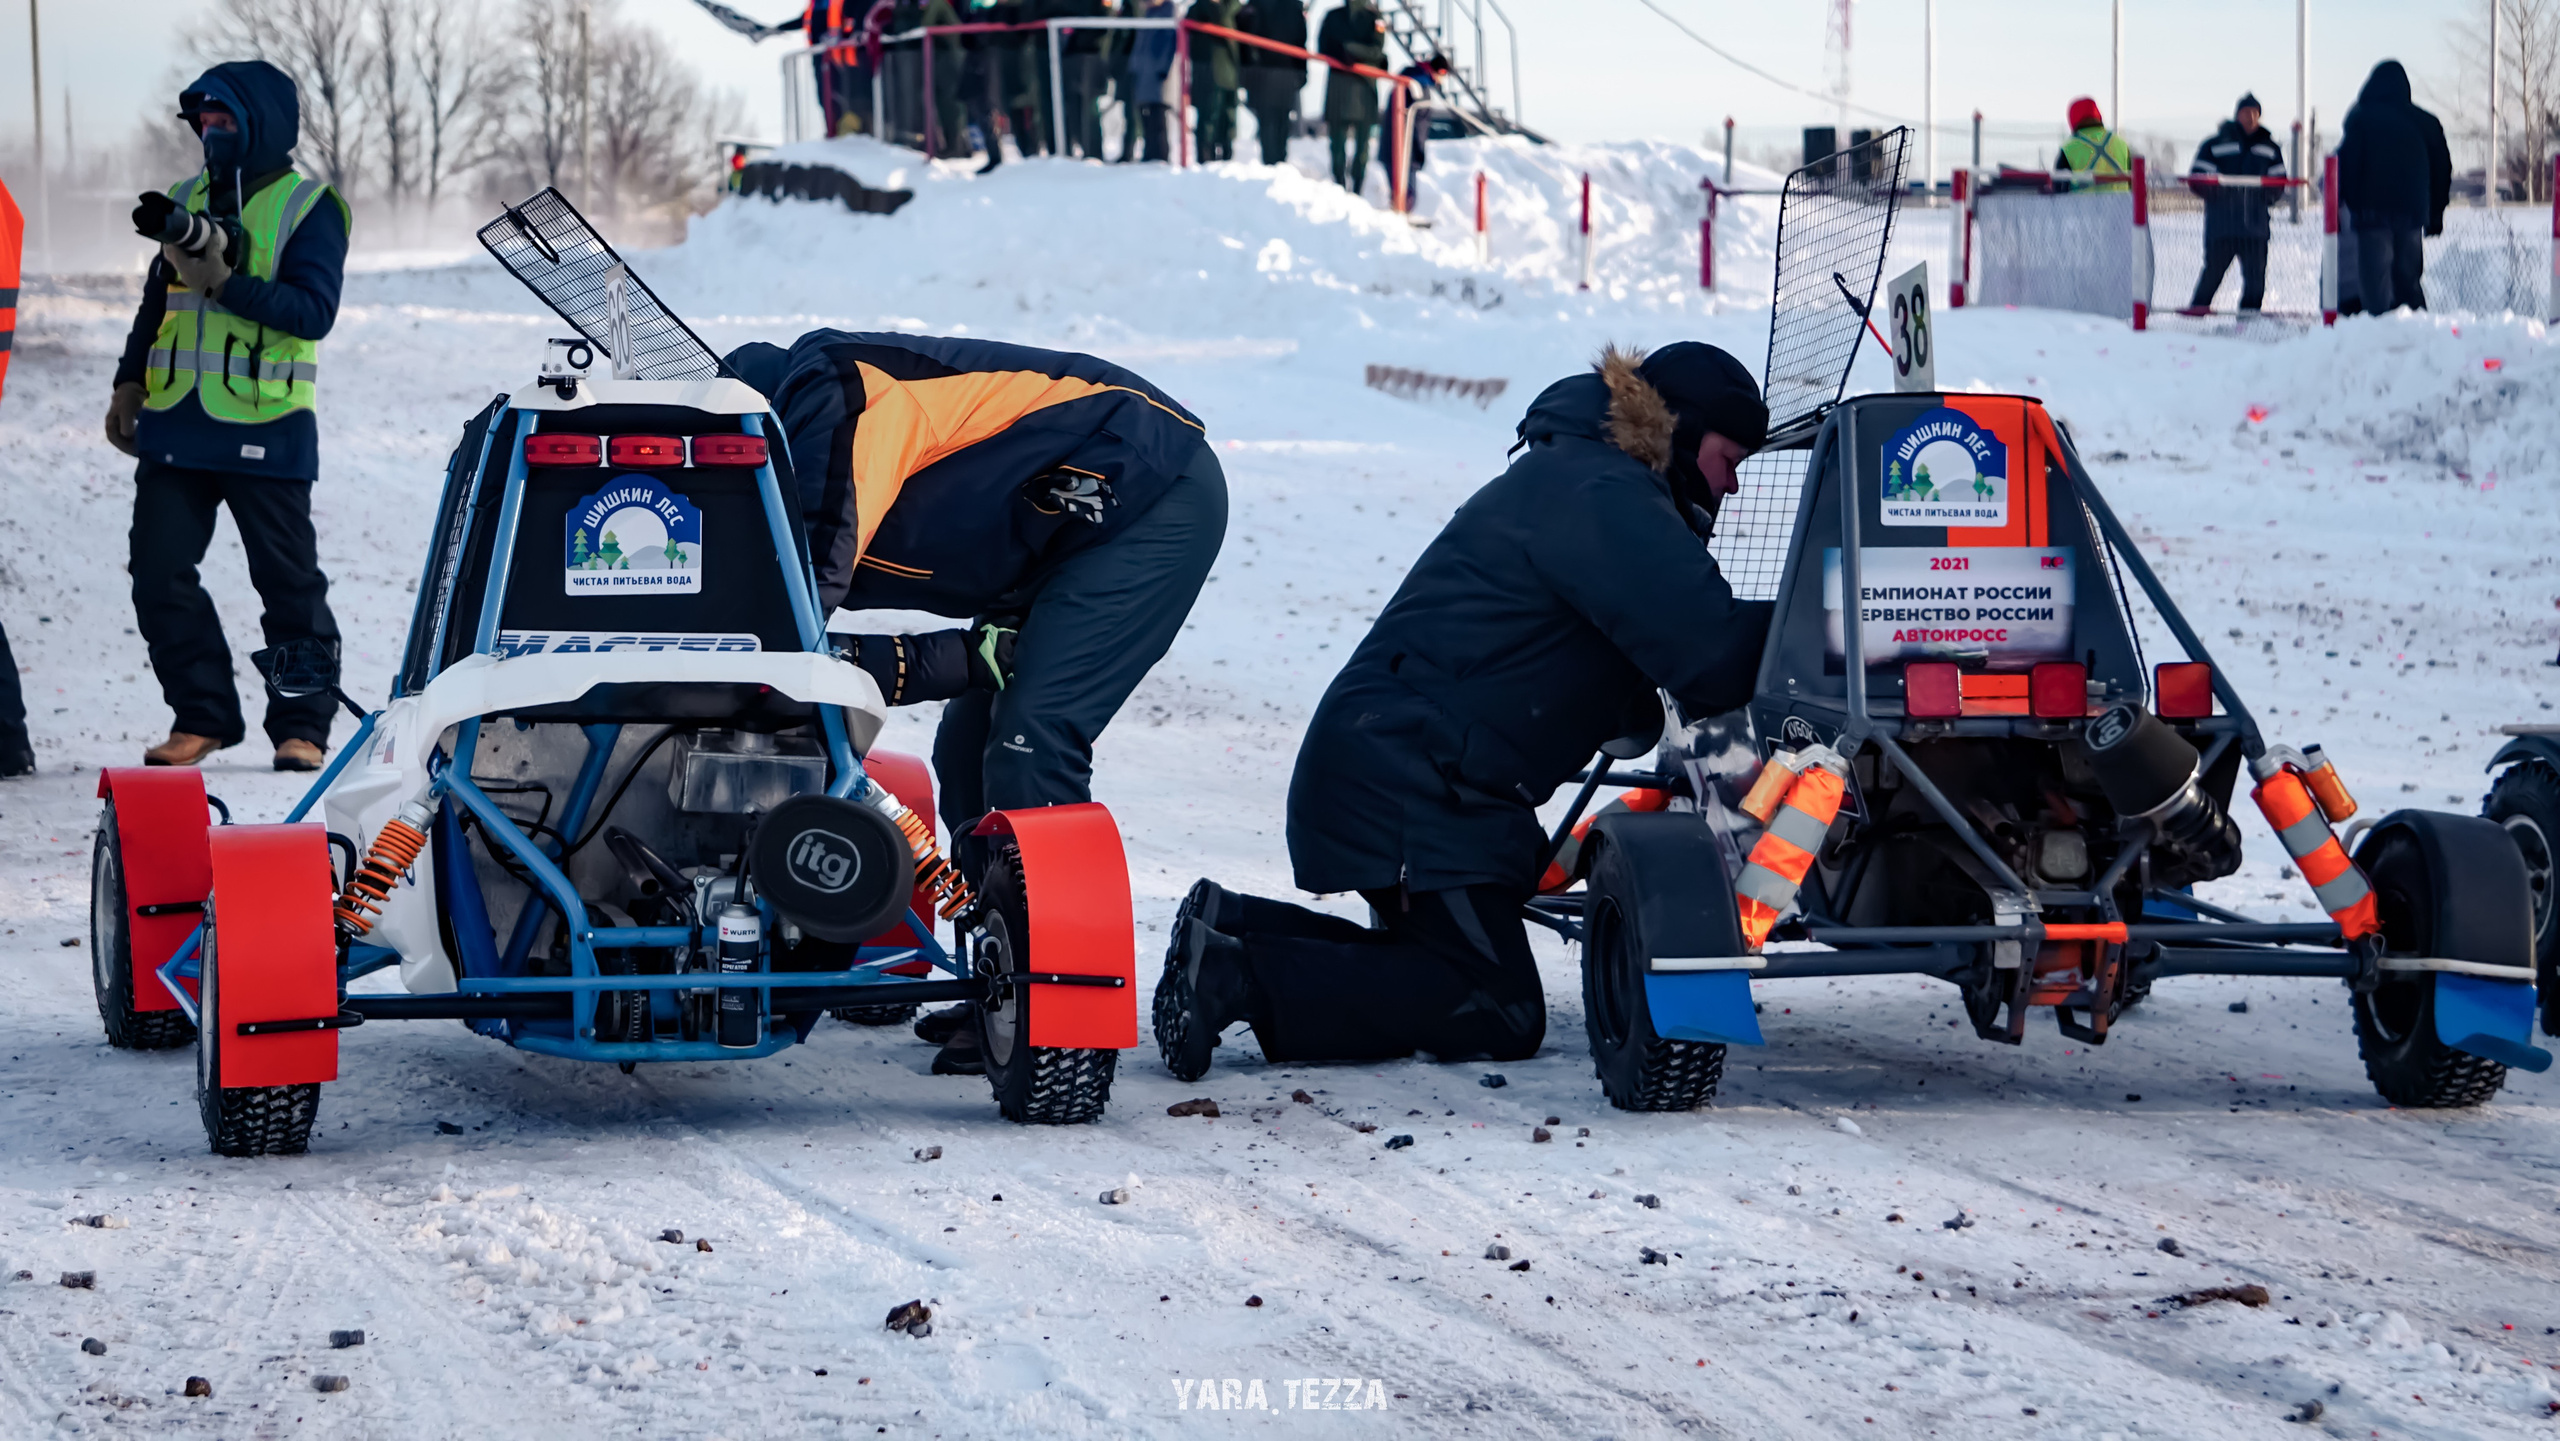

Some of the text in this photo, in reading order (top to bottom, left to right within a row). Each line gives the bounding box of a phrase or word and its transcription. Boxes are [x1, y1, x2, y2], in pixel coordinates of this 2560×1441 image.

[1894, 284, 1928, 377] 38
[1897, 422, 1991, 461] ШИШКИН ЛЕС
[583, 487, 684, 529] ШИШКИН ЛЕС
[1887, 508, 1998, 518] ЧИСТАЯ ПИТЬЕВАЯ ВОДА
[1930, 557, 1969, 570] 2021
[573, 575, 692, 586] ЧИСТАЯ ПИТЬЕВАЯ ВОДА
[1861, 586, 2051, 600] ЕМПИОНАТ РОССИИ
[1861, 607, 2053, 621] ЕРВЕНСТВО РОССИИ
[1892, 629, 2007, 642] АВТОКРОСС
[795, 834, 851, 887] itg
